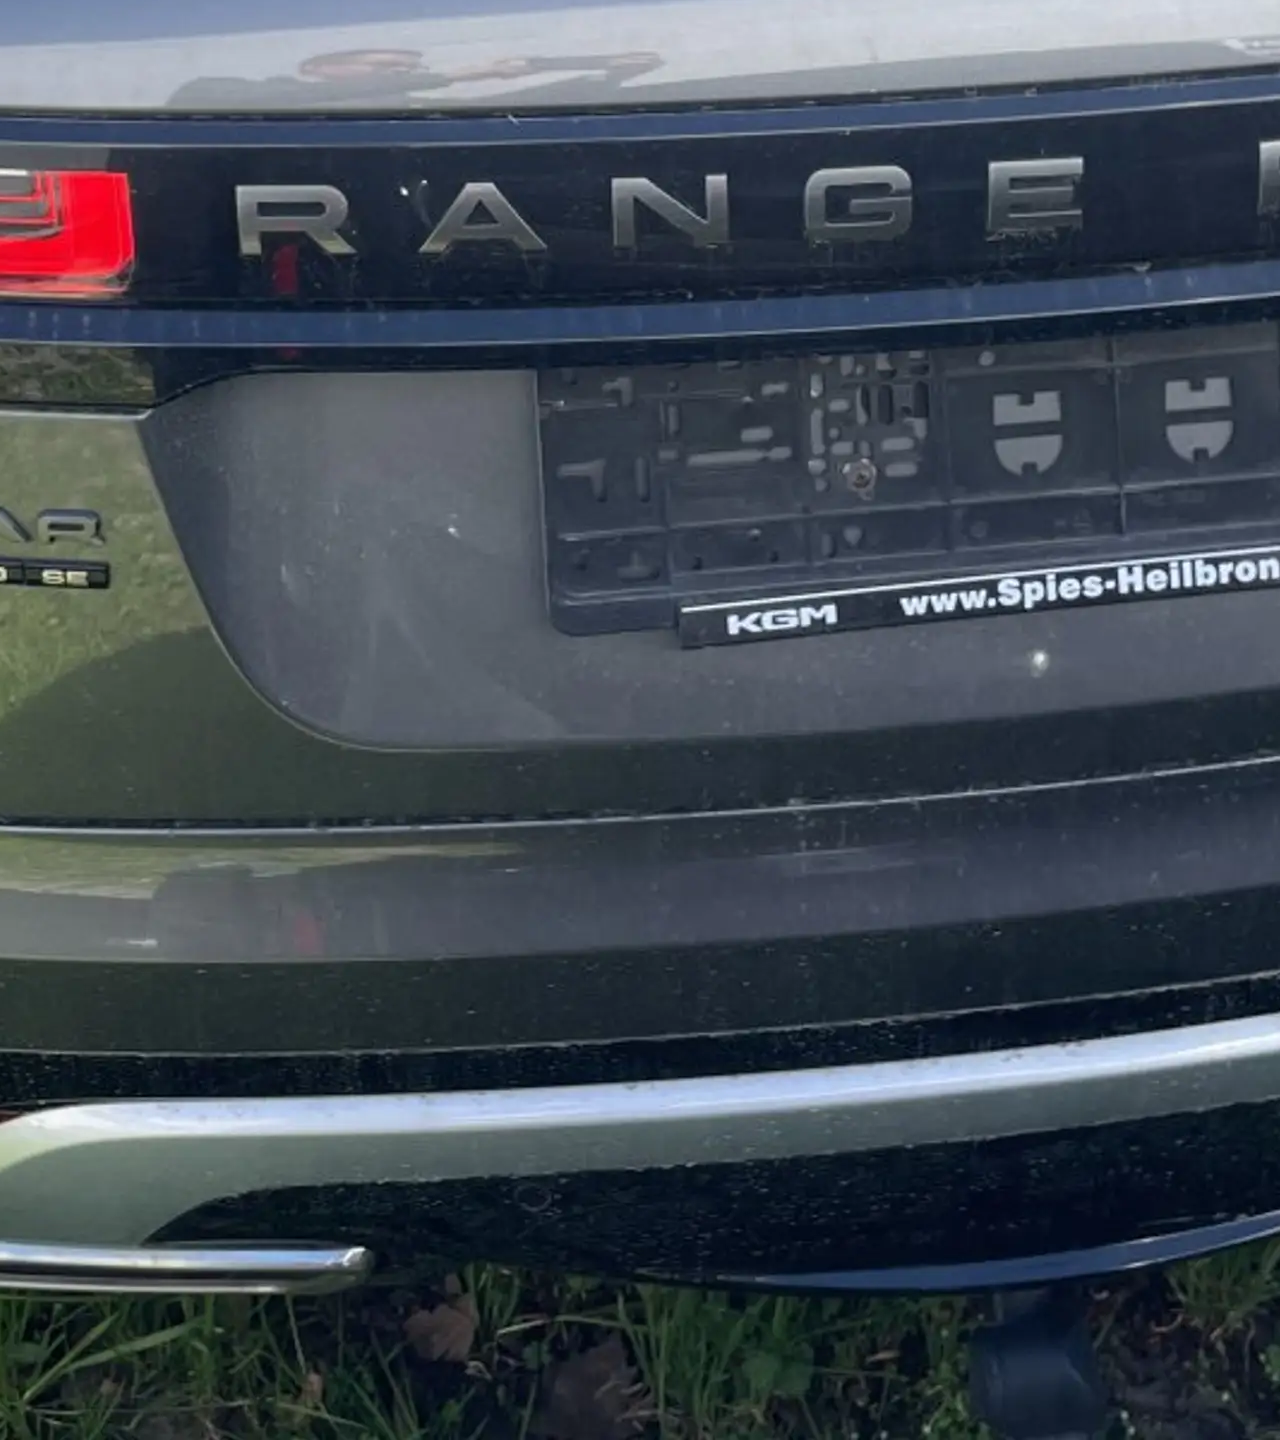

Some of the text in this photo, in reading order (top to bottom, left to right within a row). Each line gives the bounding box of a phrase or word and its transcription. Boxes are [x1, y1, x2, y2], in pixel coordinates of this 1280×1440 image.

[235, 154, 1086, 256] RANGE
[40, 568, 89, 588] SE
[726, 602, 838, 636] KGM
